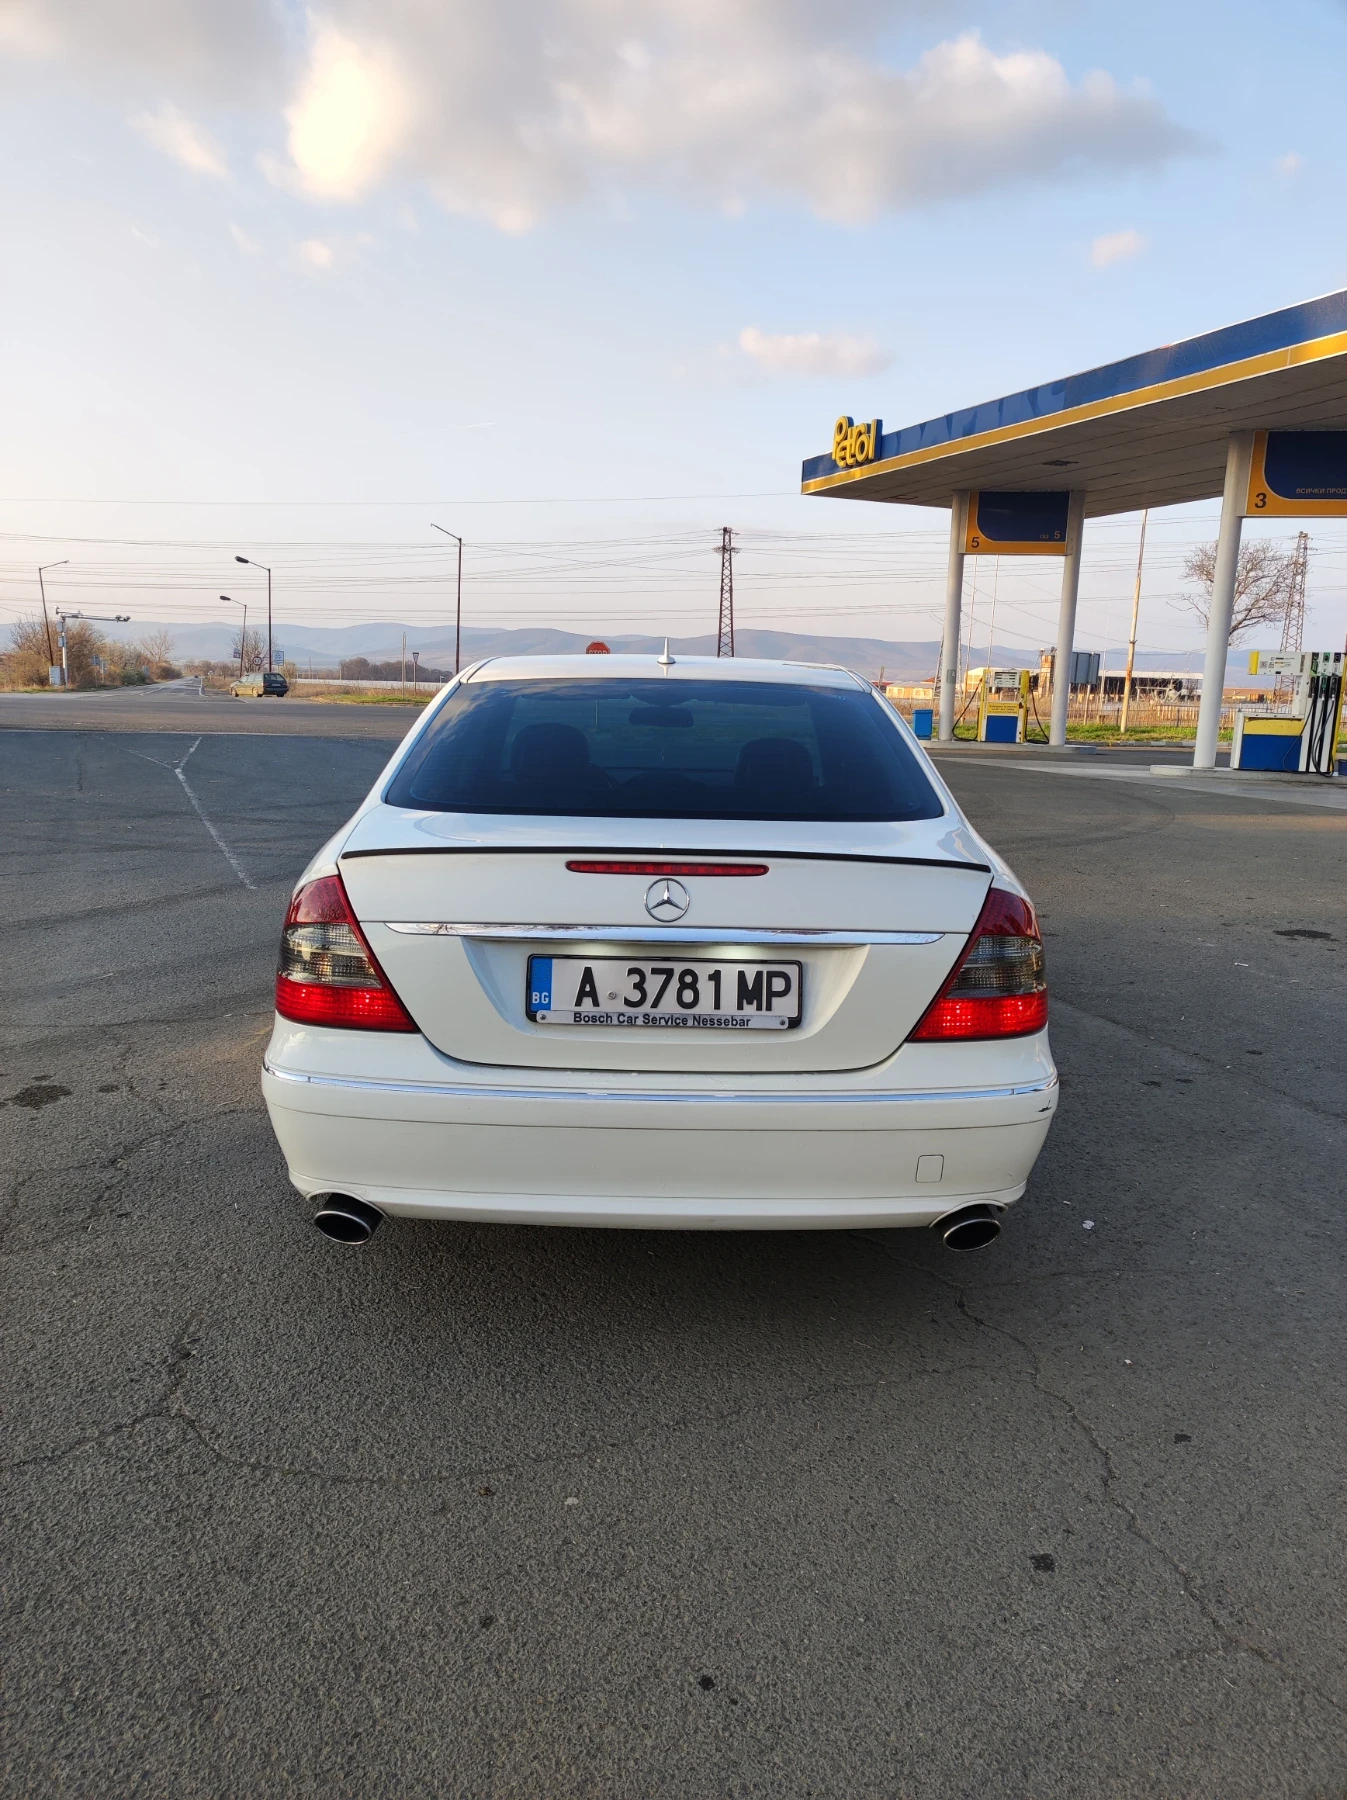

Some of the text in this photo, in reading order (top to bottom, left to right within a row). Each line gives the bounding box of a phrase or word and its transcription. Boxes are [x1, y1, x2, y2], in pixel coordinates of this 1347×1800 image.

[1254, 492, 1267, 509] 3
[1054, 531, 1060, 539] 5
[971, 536, 980, 548] 5
[574, 967, 791, 1011] A 3781 MP
[532, 992, 549, 1004] BG
[573, 1013, 751, 1027] Bosch Car Service Nessebar
